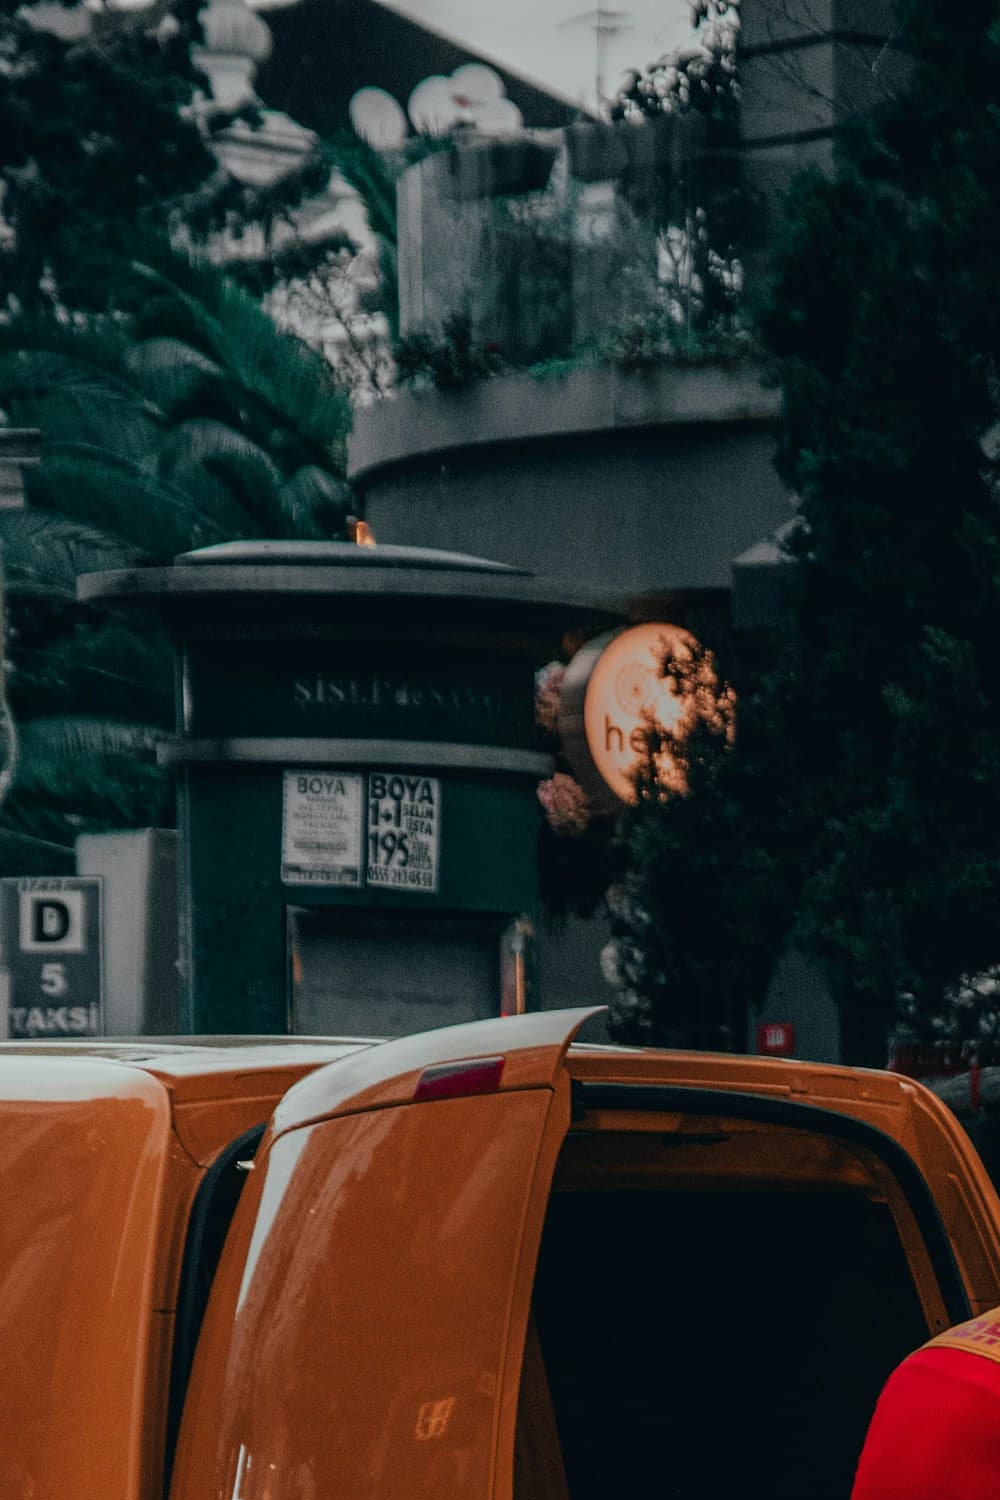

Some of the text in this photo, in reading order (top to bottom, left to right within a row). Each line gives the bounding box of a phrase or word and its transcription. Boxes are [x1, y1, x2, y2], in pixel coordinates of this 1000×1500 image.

[297, 777, 345, 795] BOYA
[370, 775, 433, 804] BOYA
[369, 831, 409, 867] 195
[33, 900, 70, 941] D
[41, 962, 68, 997] 5
[11, 1001, 98, 1033] TAKSİ
